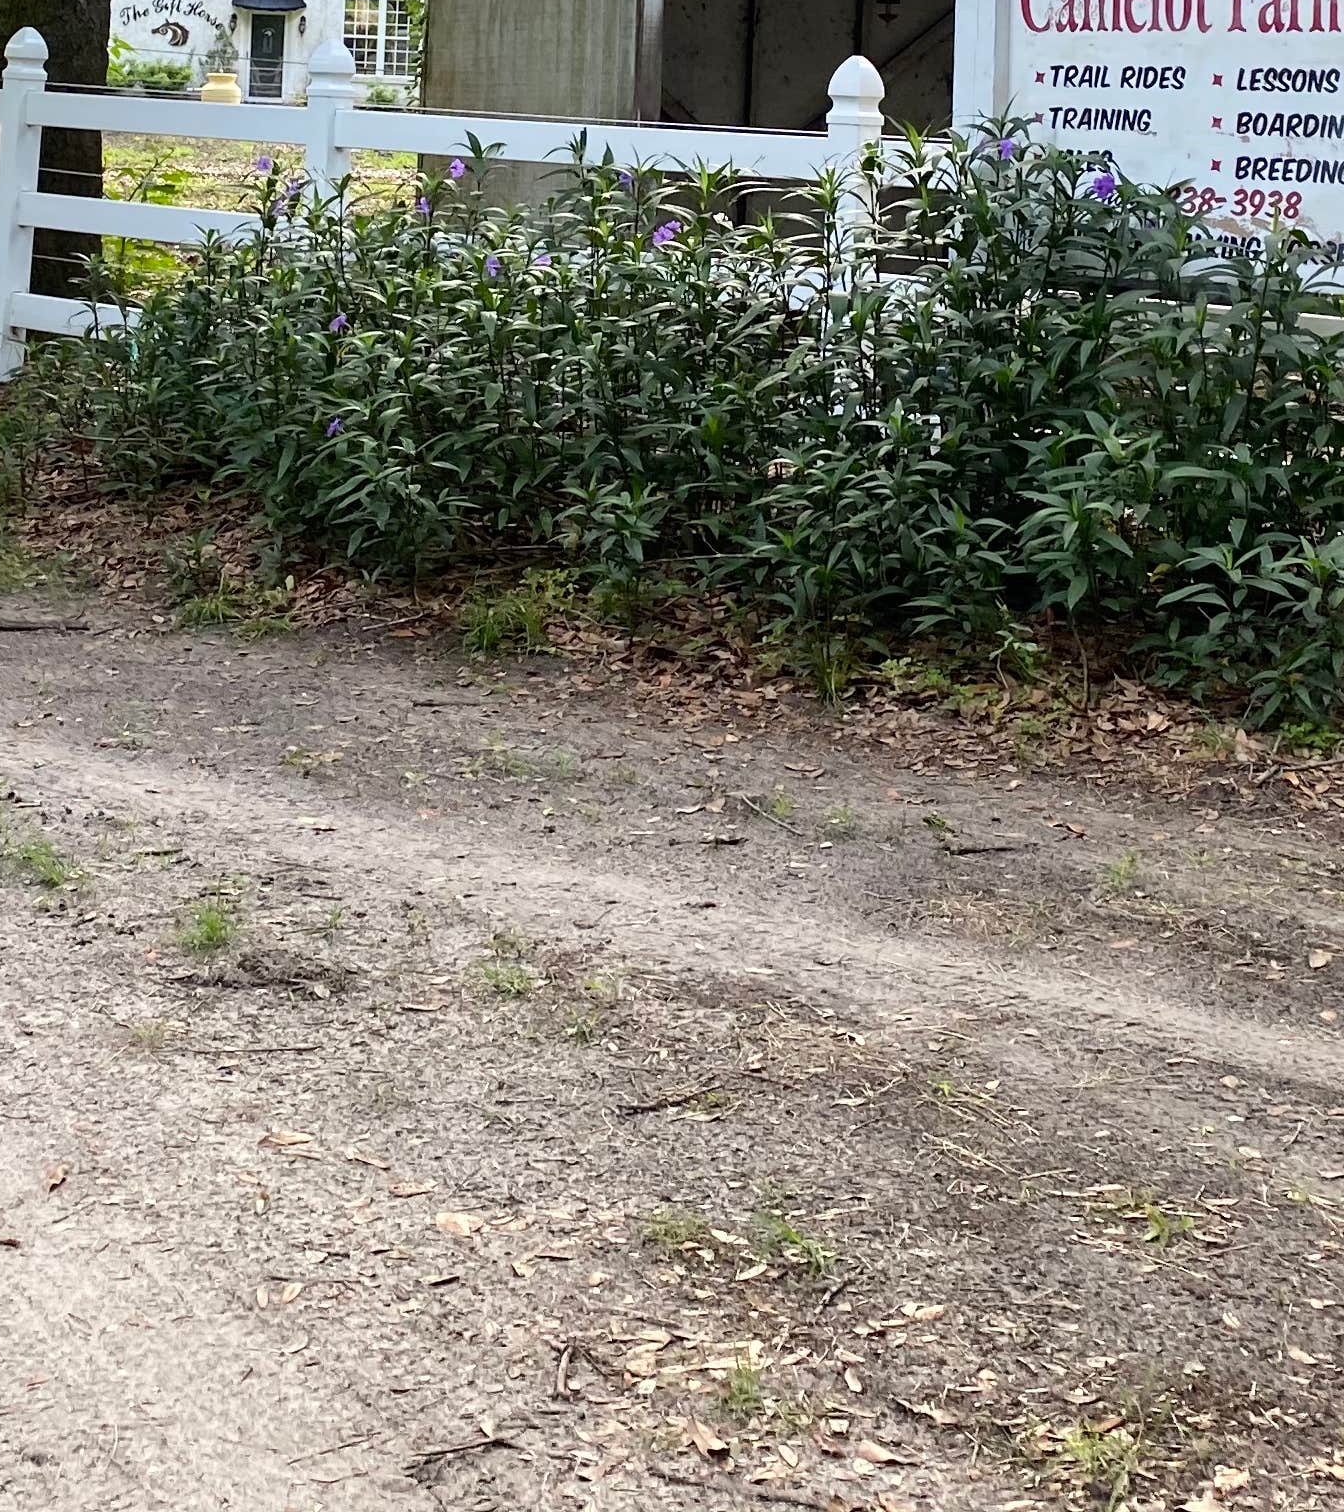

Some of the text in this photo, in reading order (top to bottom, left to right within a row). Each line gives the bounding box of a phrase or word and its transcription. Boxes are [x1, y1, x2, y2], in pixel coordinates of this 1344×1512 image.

[119, 4, 150, 26] The
[183, 1, 224, 30] Horse
[1050, 65, 1186, 91] TRAIL RIDES
[1237, 68, 1340, 94] LESSONS
[1050, 107, 1153, 133] TRAINING
